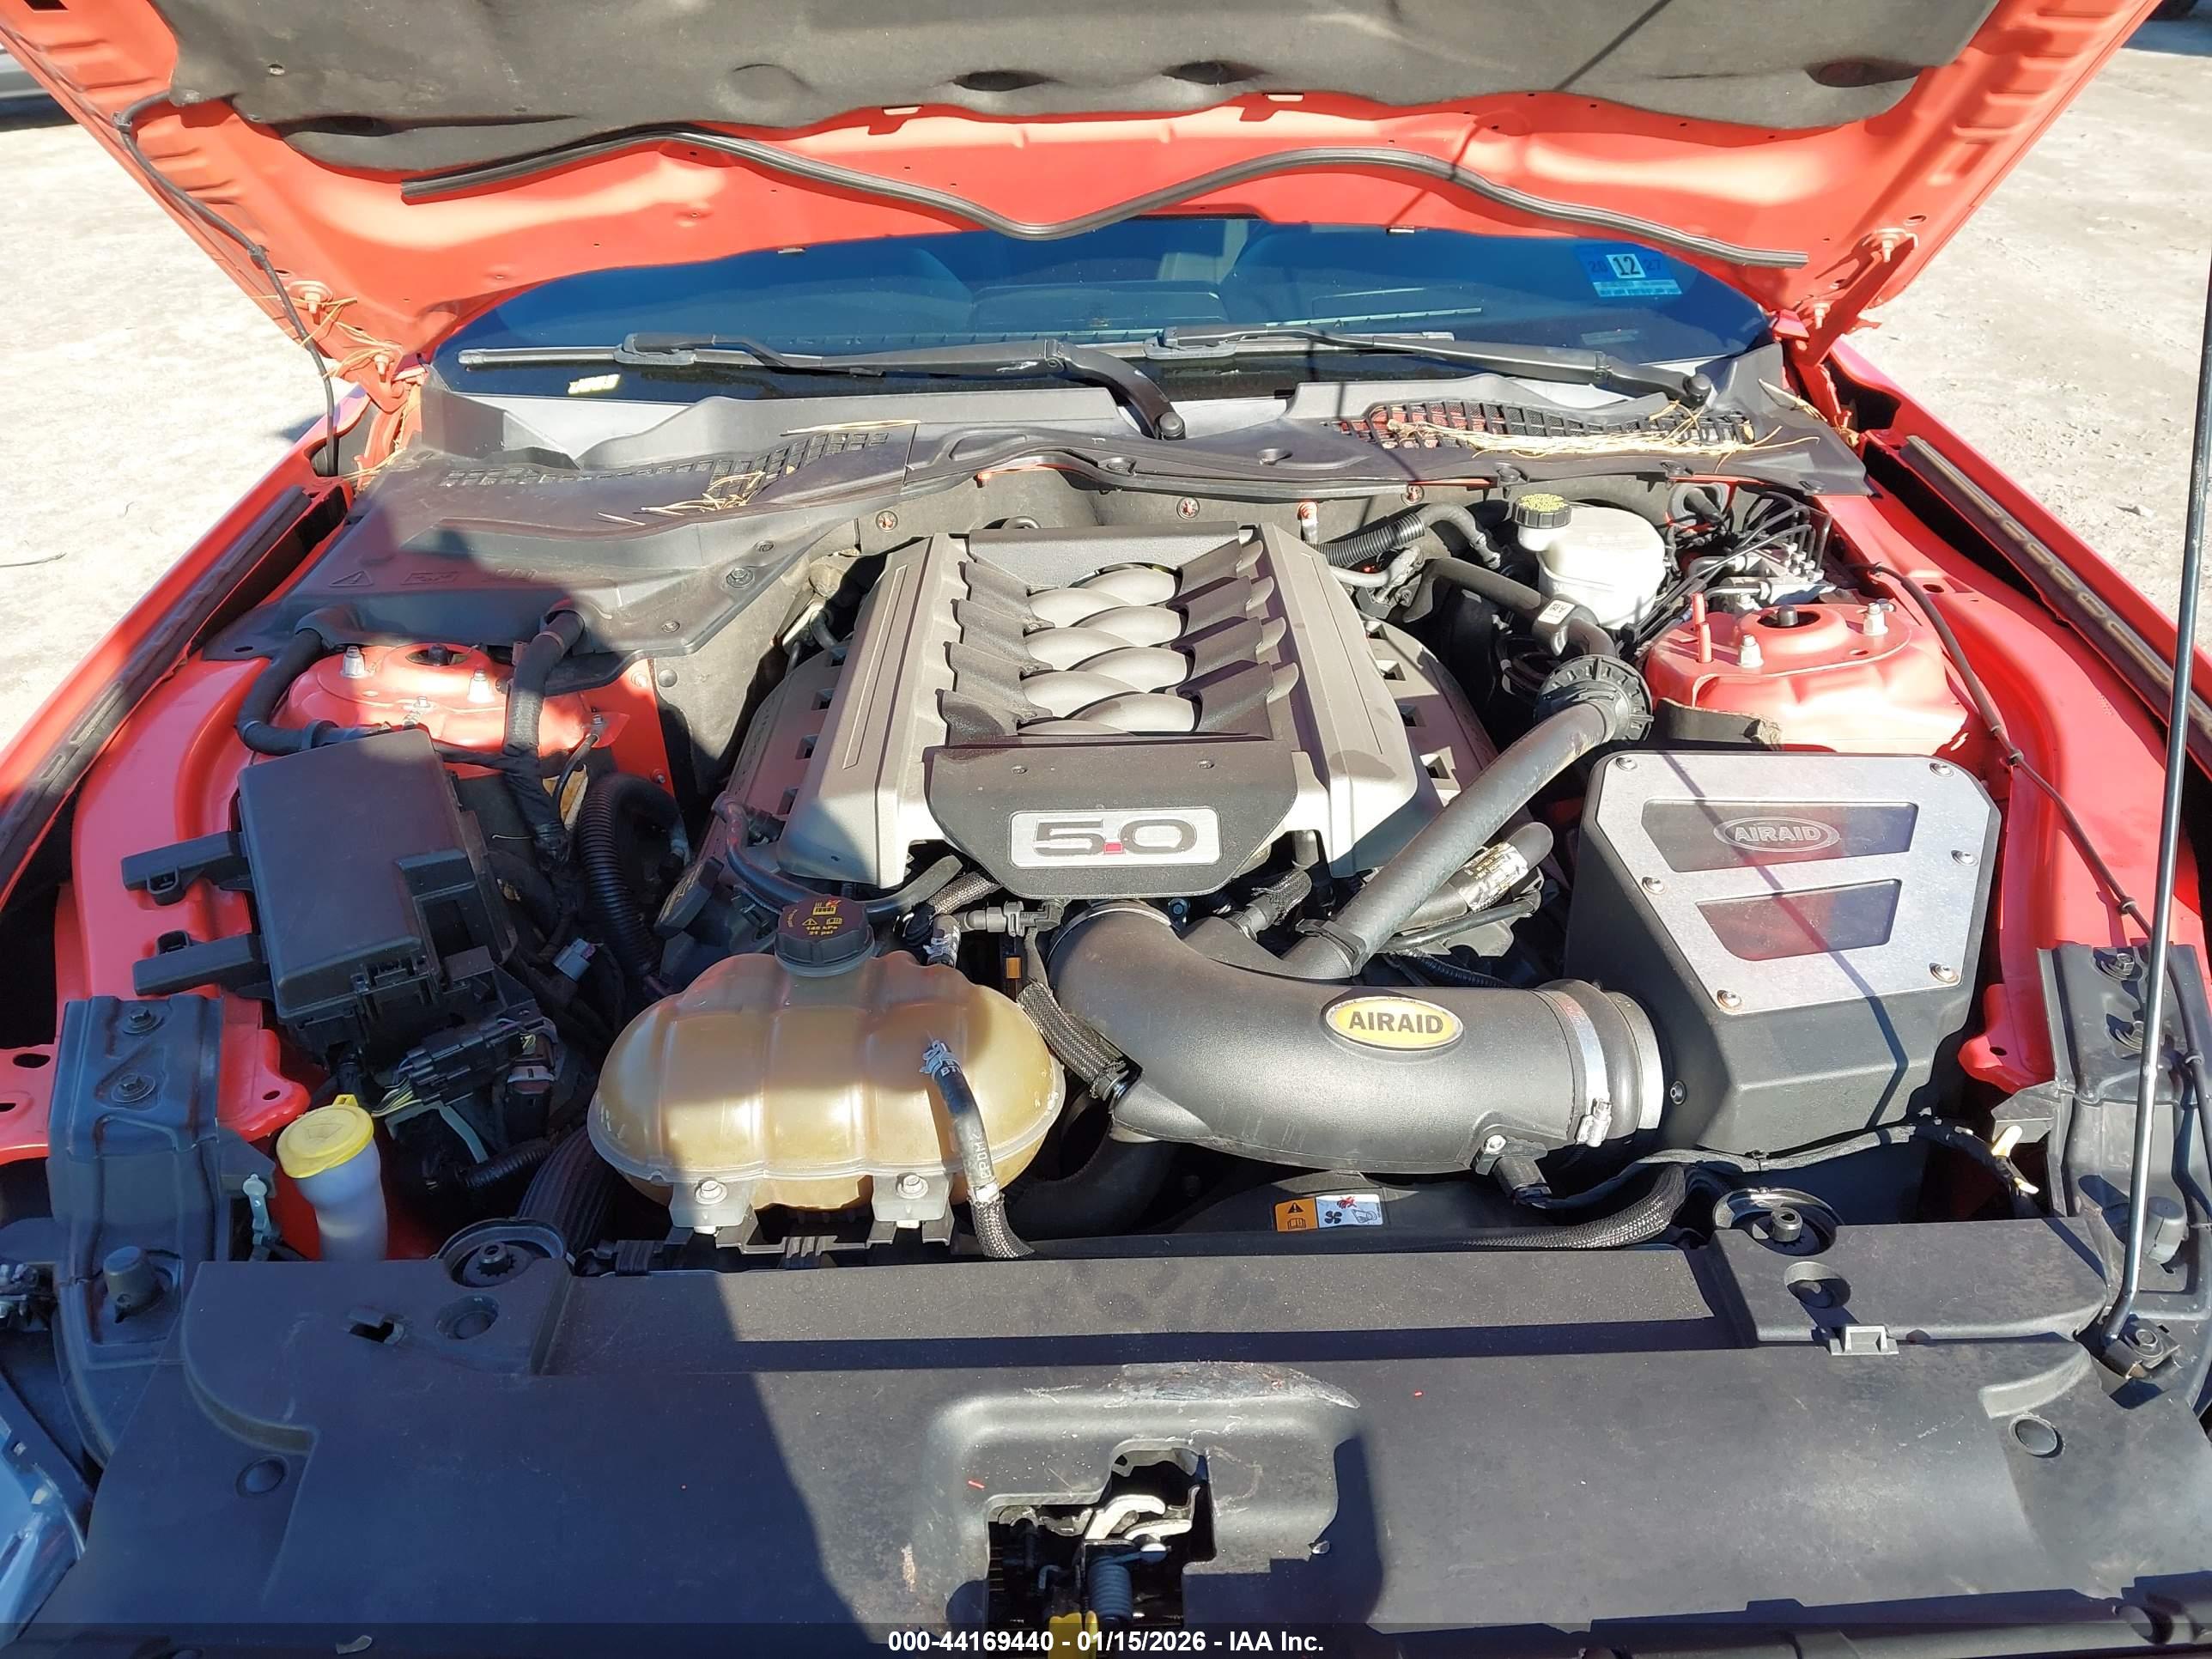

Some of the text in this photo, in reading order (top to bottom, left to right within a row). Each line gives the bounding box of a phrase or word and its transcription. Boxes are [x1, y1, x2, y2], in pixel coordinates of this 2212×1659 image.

[1613, 256, 1640, 276] 12
[1032, 817, 1198, 856] 5.0
[1735, 825, 1822, 842] AIRAID
[1349, 1011, 1444, 1034] AIRAID
